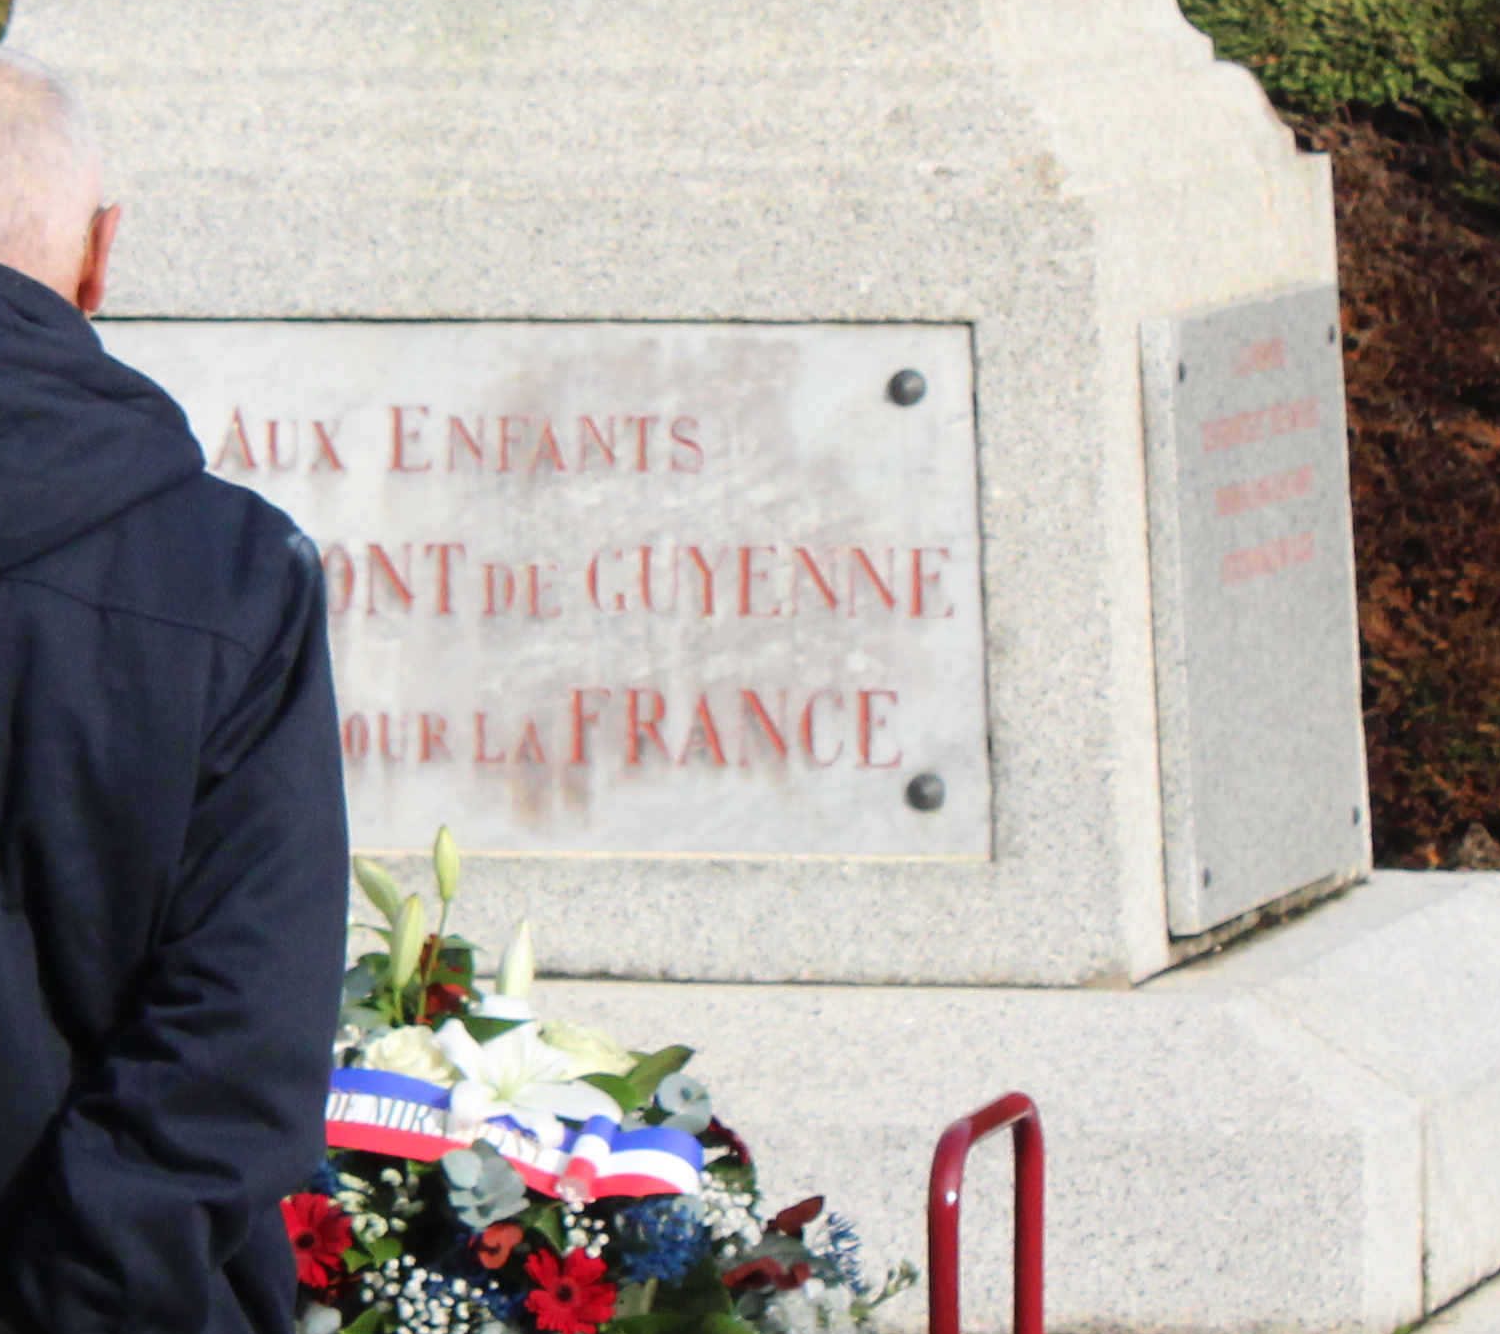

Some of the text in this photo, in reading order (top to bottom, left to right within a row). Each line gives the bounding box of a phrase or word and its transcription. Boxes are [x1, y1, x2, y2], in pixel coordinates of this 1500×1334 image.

[321, 541, 955, 620] ONT DE GUYENNE
[341, 687, 902, 768] OUR LA FRANCE
